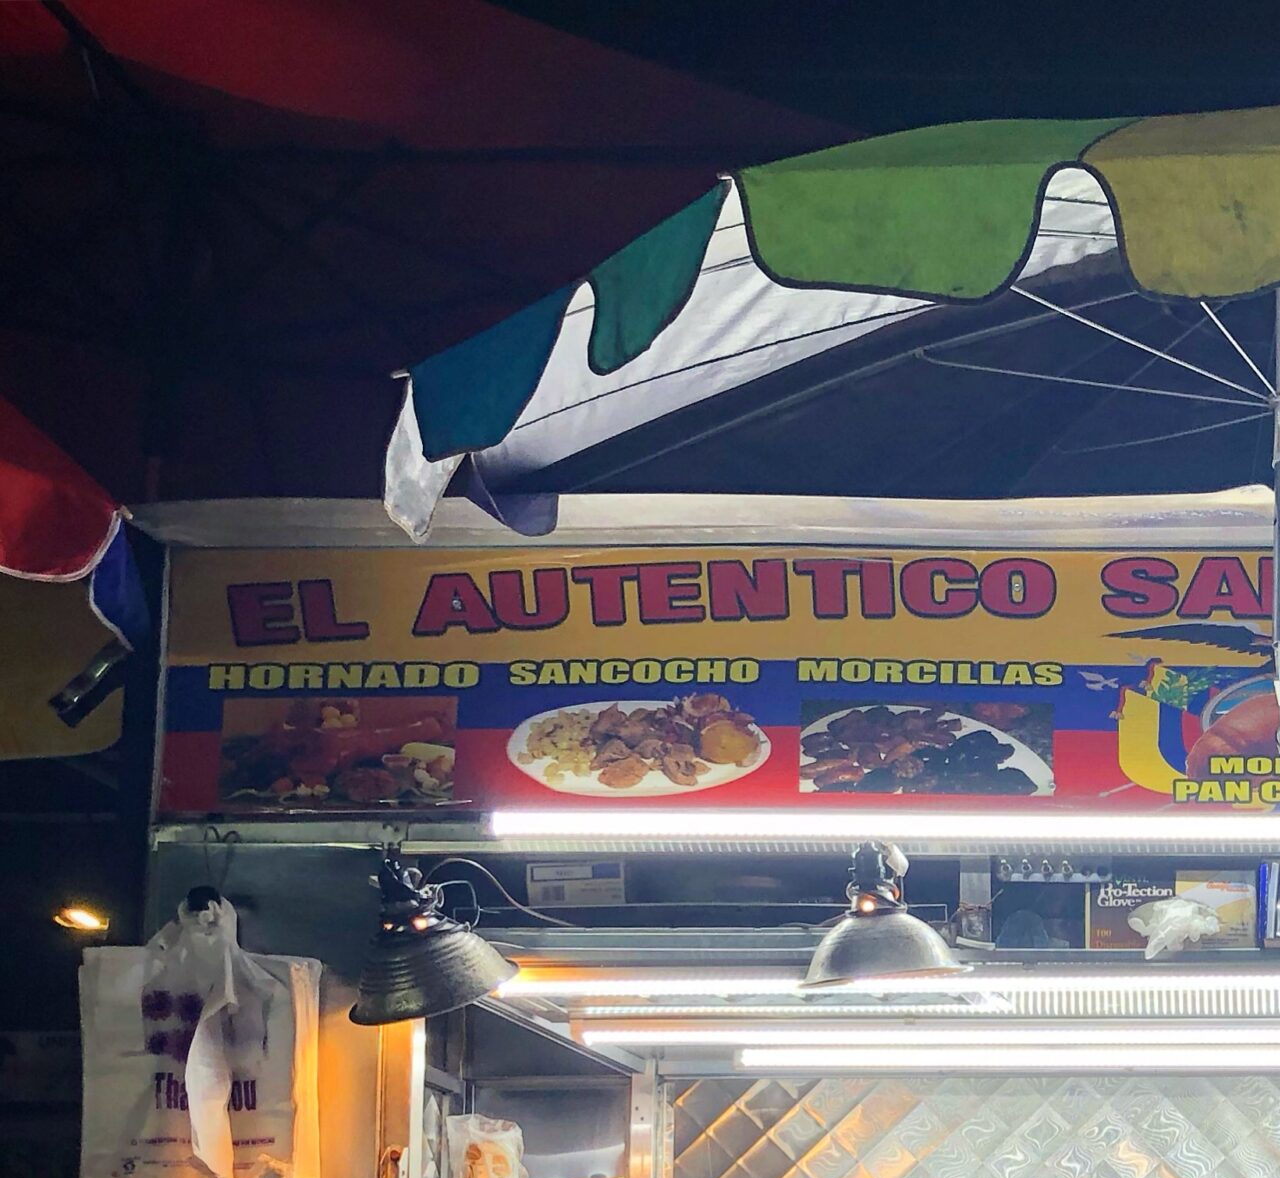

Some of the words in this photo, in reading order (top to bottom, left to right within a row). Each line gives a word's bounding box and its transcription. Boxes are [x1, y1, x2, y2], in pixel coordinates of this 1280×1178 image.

[226, 579, 370, 647] EL
[411, 557, 1058, 637] AUTENTICO
[208, 660, 481, 691] HORNADO
[508, 658, 762, 687] SANCOCHO
[796, 658, 1065, 688] MORCILLAS
[1173, 779, 1250, 803] PAN
[155, 1072, 189, 1111] Tha
[227, 1080, 257, 1112] ou
